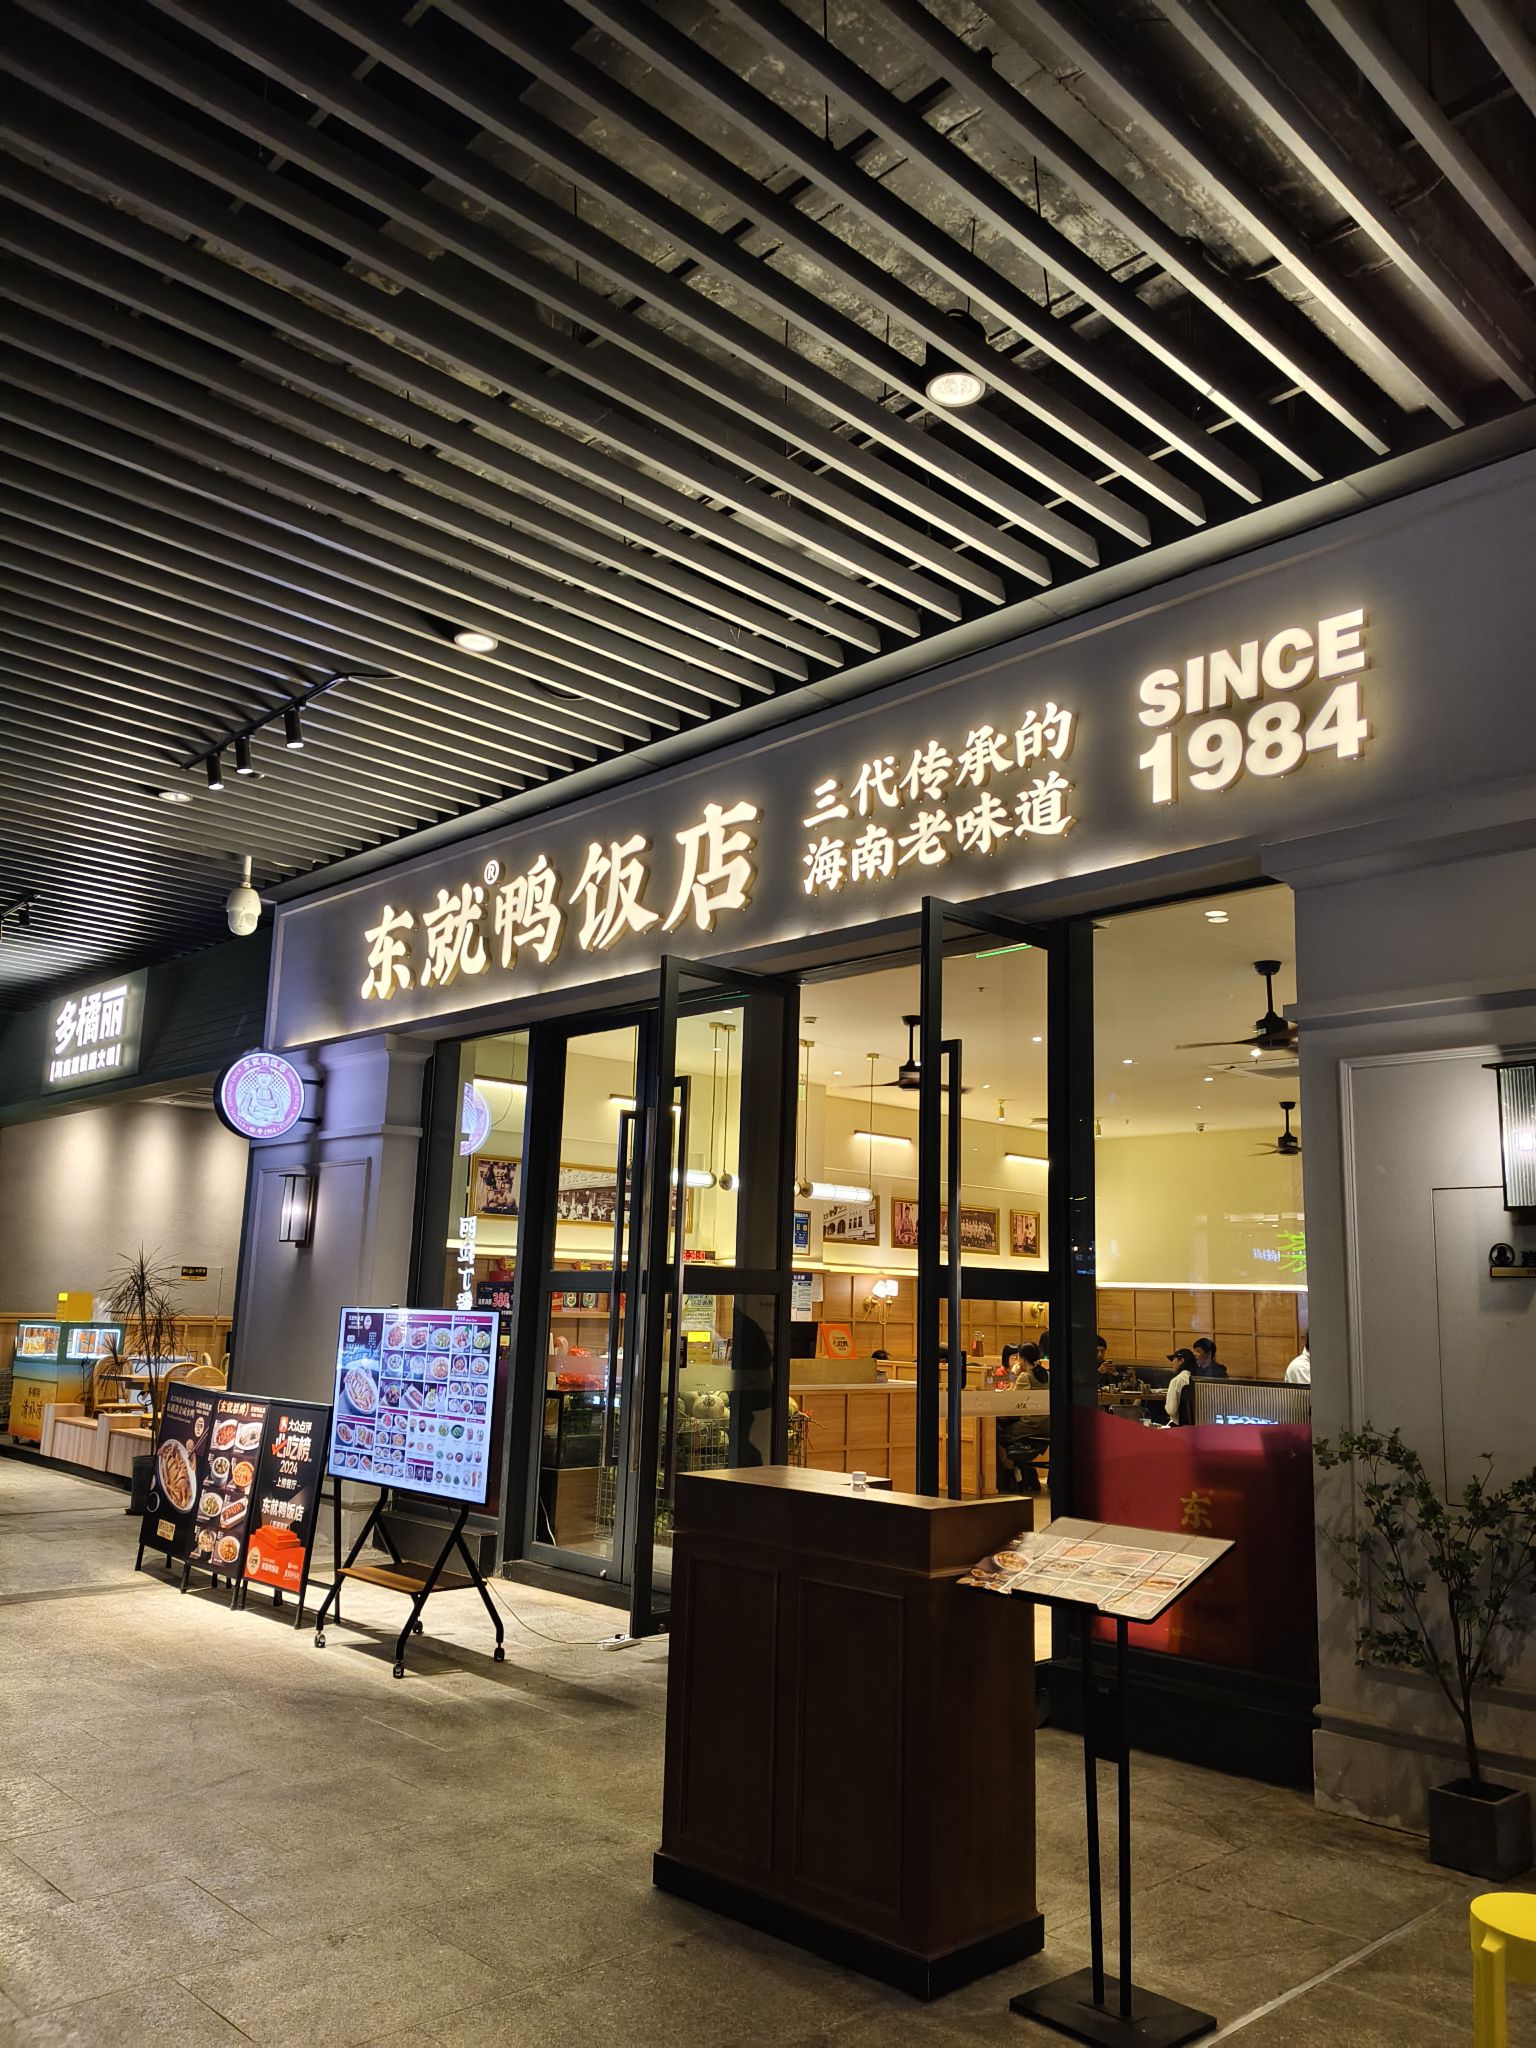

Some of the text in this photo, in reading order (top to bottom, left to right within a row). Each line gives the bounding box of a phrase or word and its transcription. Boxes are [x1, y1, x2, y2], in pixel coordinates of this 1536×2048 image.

[1138, 608, 1367, 729] SINCE
[803, 701, 1075, 829] 三代传承的
[1138, 680, 1370, 804] 1984
[803, 770, 1073, 895] 海南老味道
[361, 800, 758, 1000] 东就鸭饭店
[279, 1460, 298, 1476] 2024
[288, 1419, 312, 1434] 大众点评
[261, 1497, 305, 1523] 东就鸭饭店
